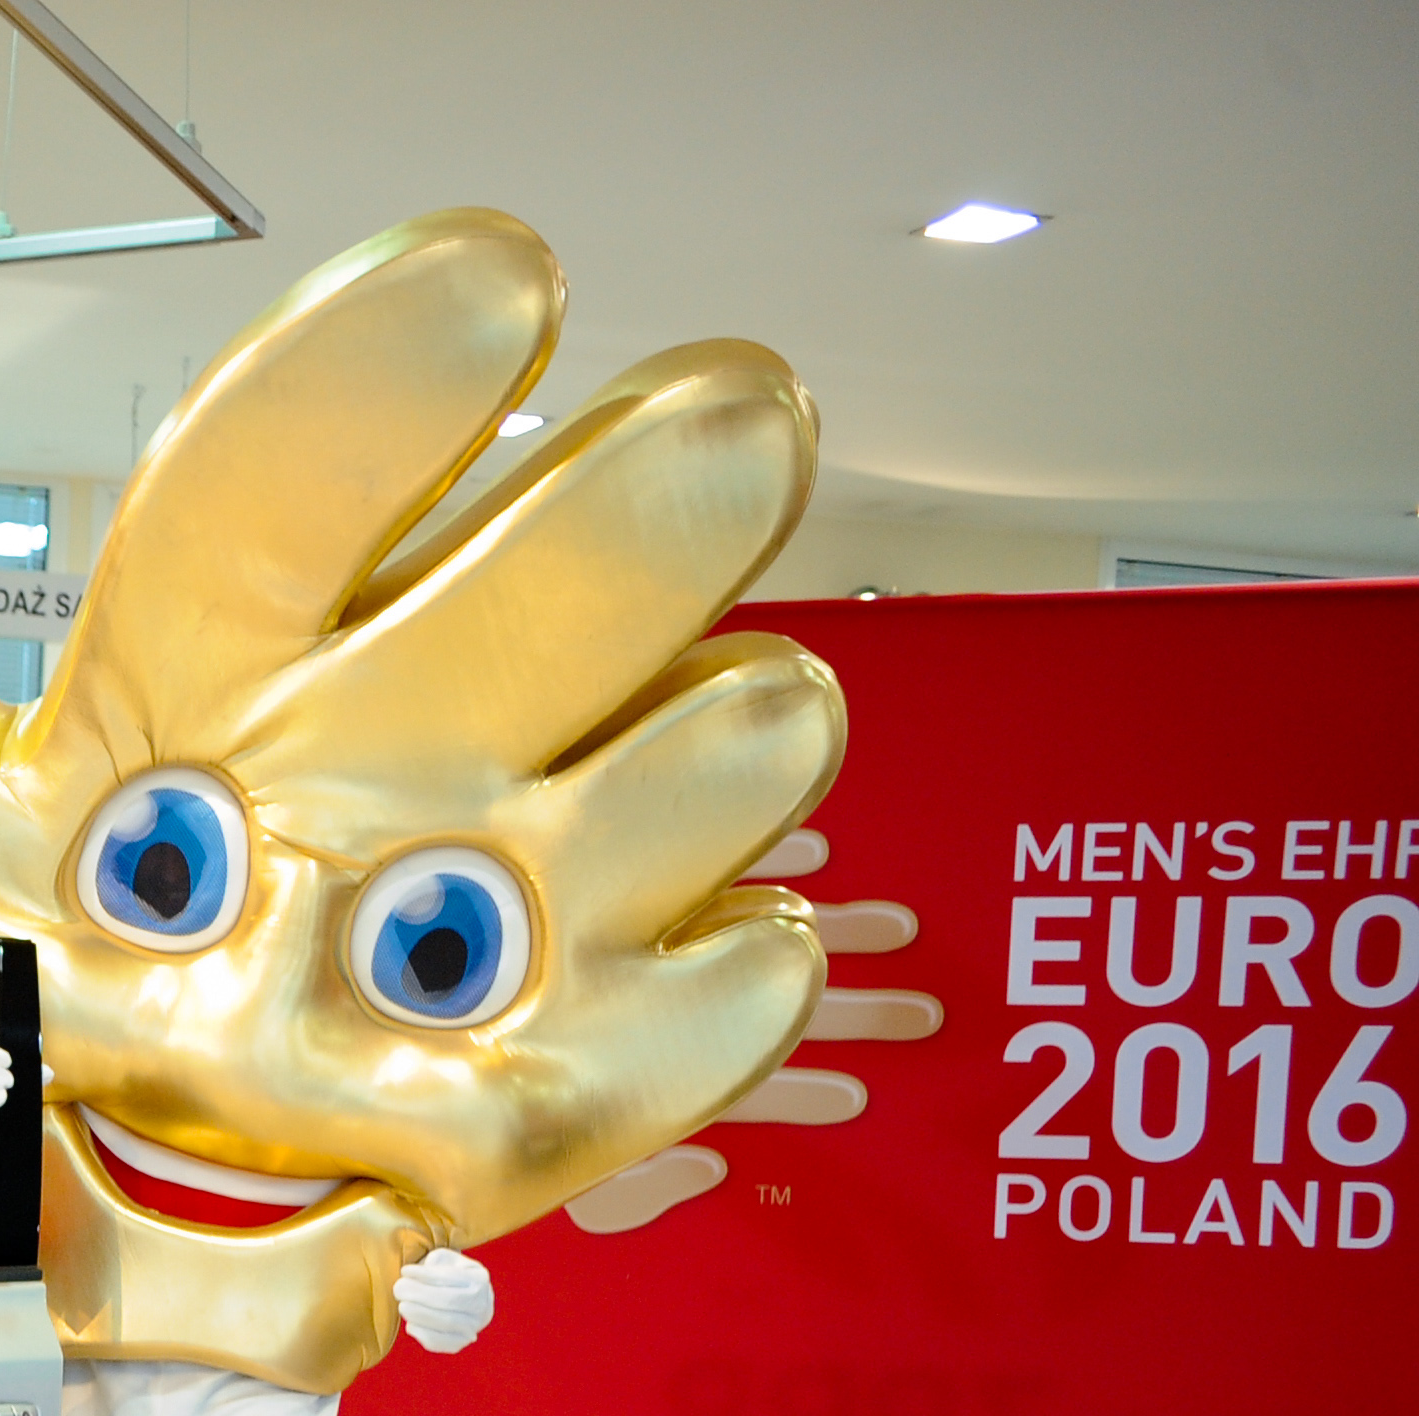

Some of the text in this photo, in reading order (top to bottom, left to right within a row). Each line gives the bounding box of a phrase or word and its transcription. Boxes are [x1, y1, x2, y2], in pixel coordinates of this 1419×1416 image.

[1013, 821, 1256, 882] MEN'S
[1006, 894, 1419, 1008] EURO
[998, 1020, 1407, 1167] 2016
[994, 1172, 1395, 1250] POLAND
